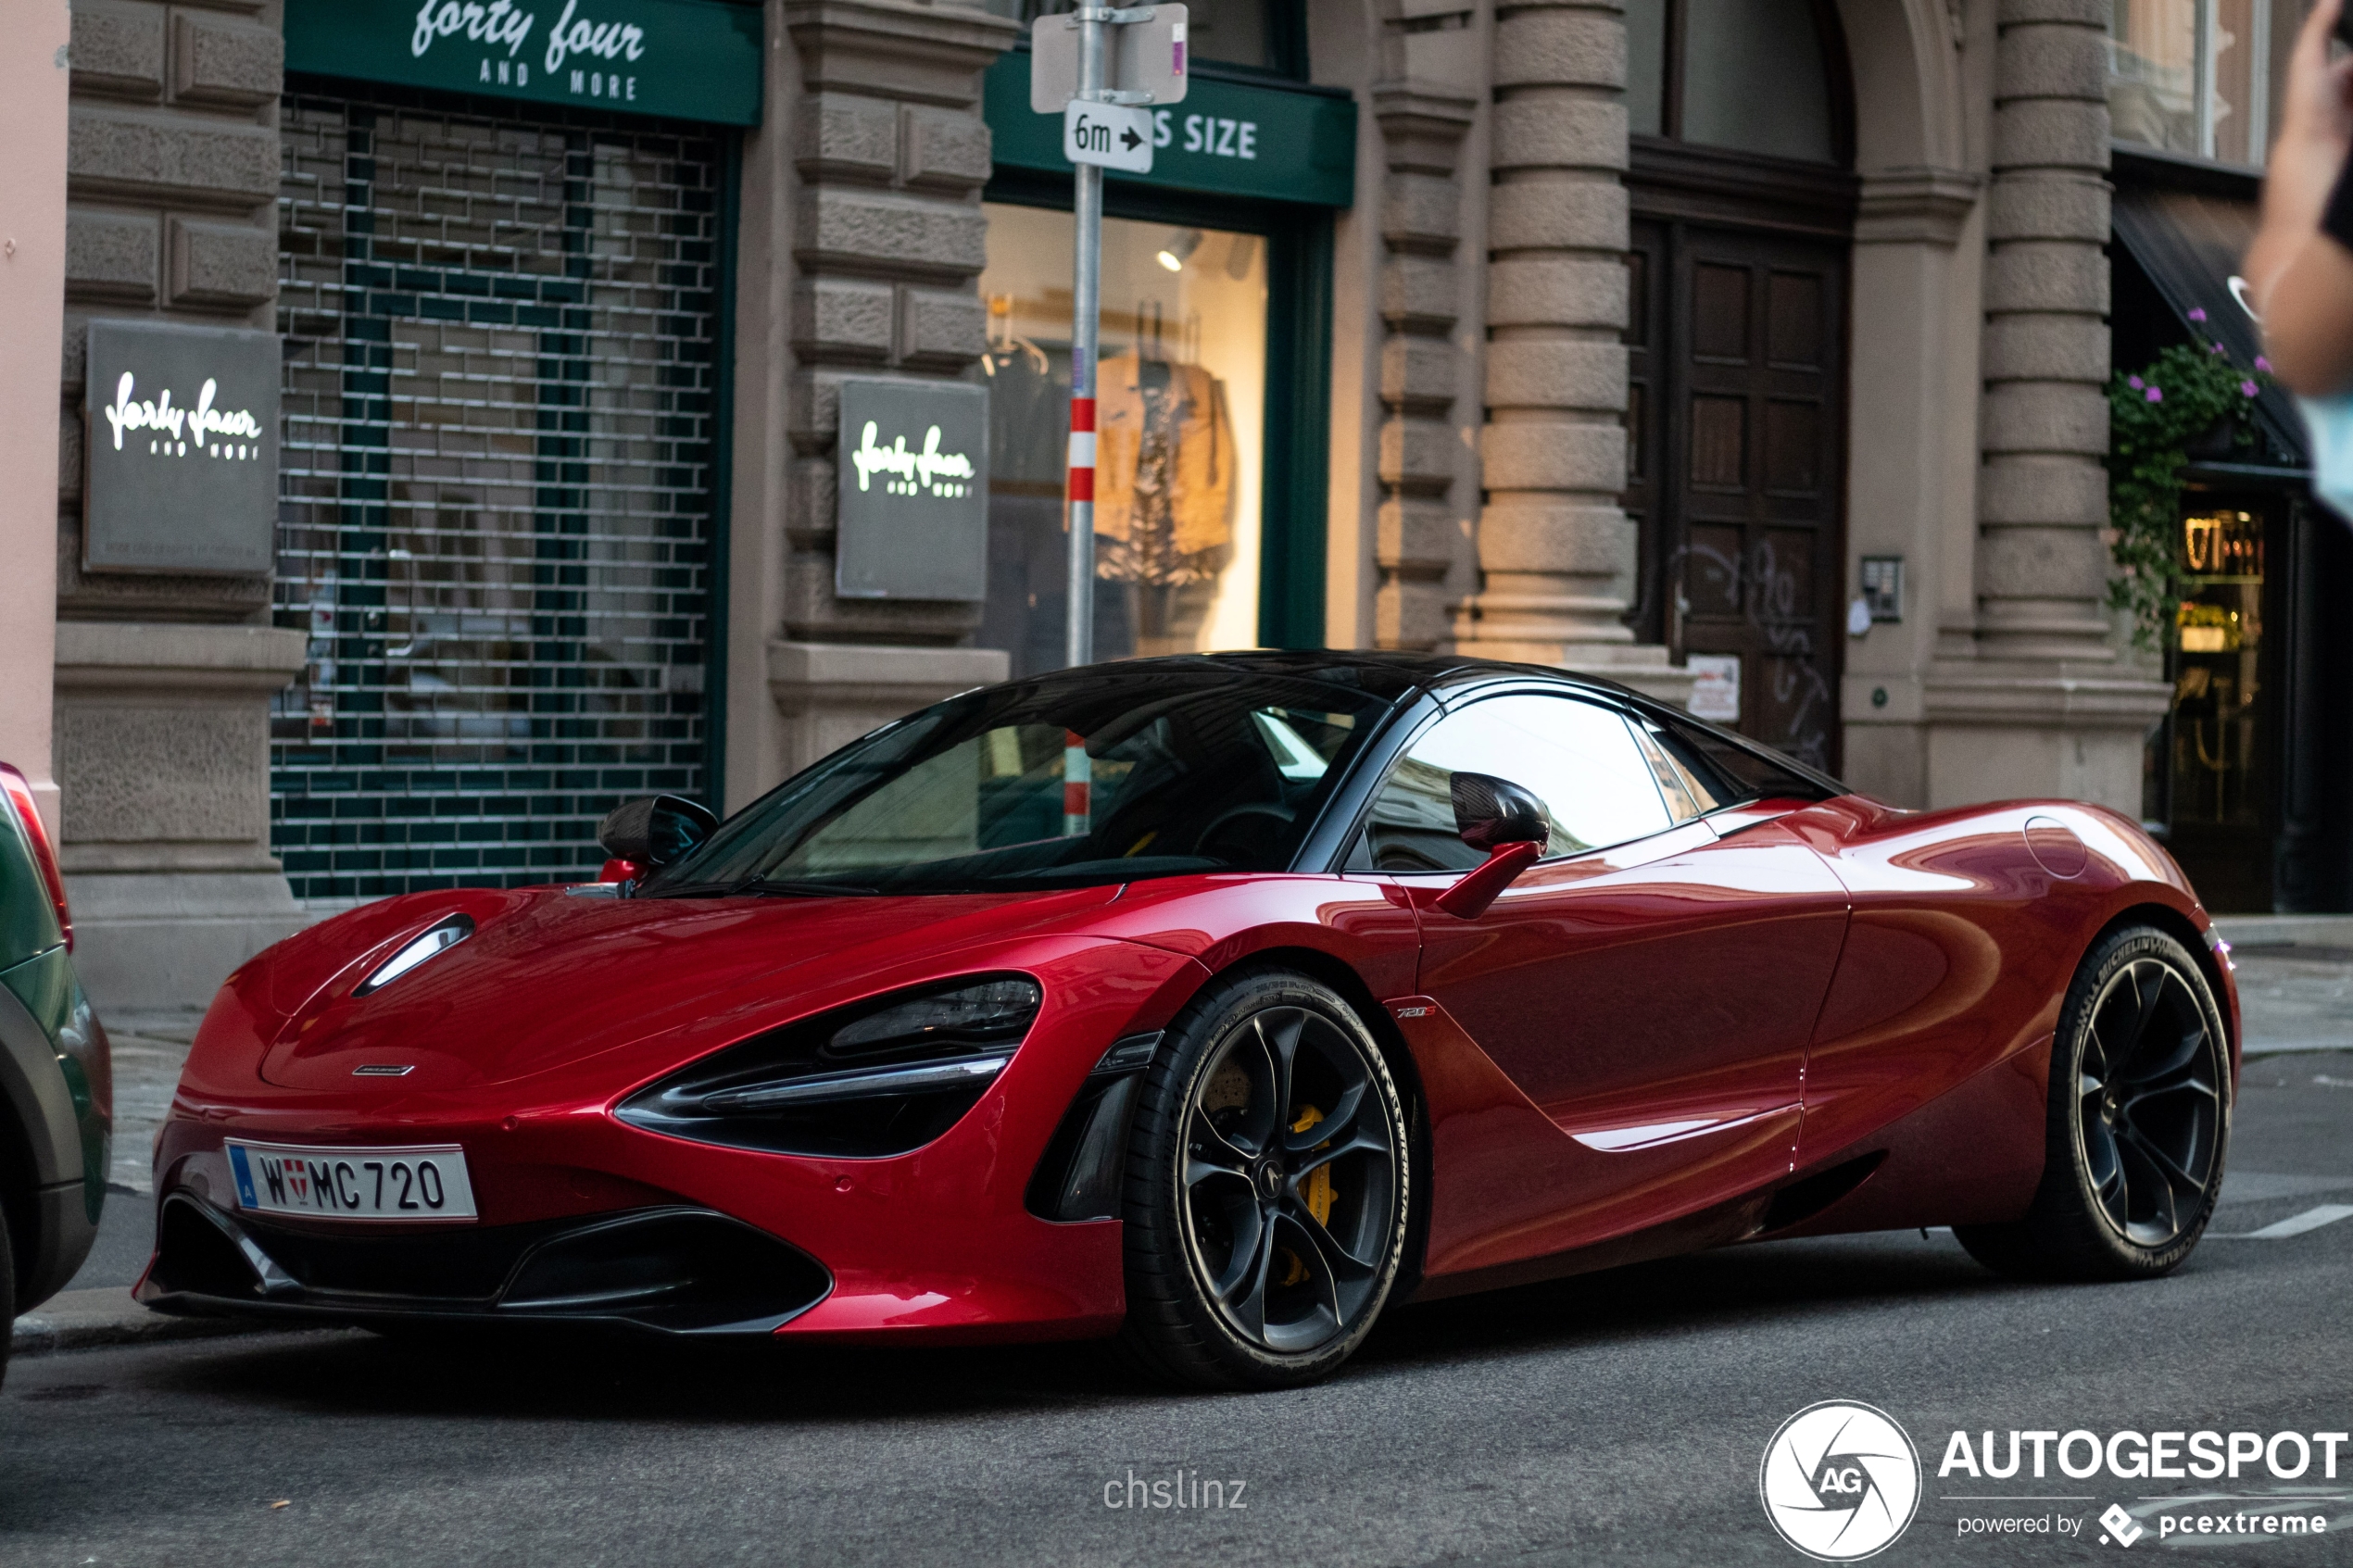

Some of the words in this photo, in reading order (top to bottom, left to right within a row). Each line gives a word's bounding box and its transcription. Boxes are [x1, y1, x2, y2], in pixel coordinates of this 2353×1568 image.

[412, 0, 534, 57] forty
[545, 0, 645, 74] four
[480, 58, 529, 86] AND
[570, 69, 636, 101] MORE
[1075, 114, 1111, 153] 6m
[1184, 115, 1257, 160] SIZE
[105, 371, 185, 451] forty
[2099, 936, 2150, 985] MICHELIN
[1397, 1006, 1436, 1018] 720S
[244, 1185, 253, 1199] A
[260, 1157, 286, 1205] W
[1397, 1122, 1410, 1224] MICHELIN
